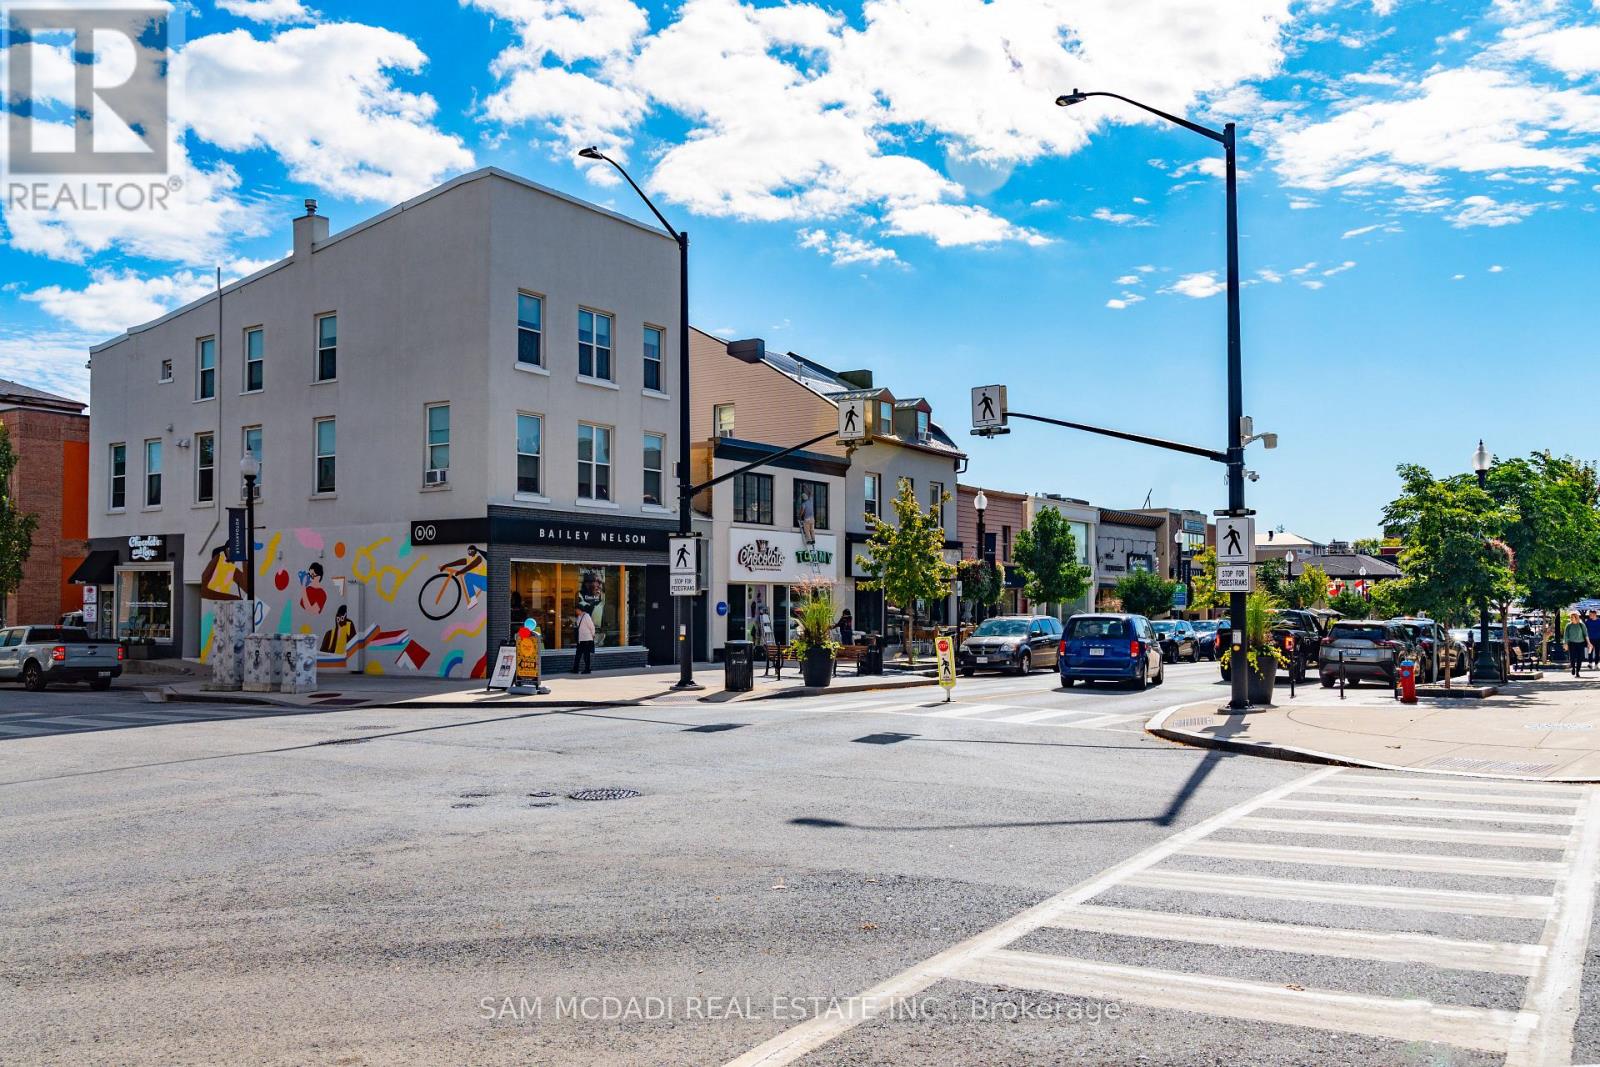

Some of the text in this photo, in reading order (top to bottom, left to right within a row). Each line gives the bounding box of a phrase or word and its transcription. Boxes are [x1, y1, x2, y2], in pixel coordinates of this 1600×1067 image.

[539, 528, 646, 544] BAILEY NELSON
[737, 544, 785, 568] Chocolate
[1222, 570, 1245, 578] STOP FOR
